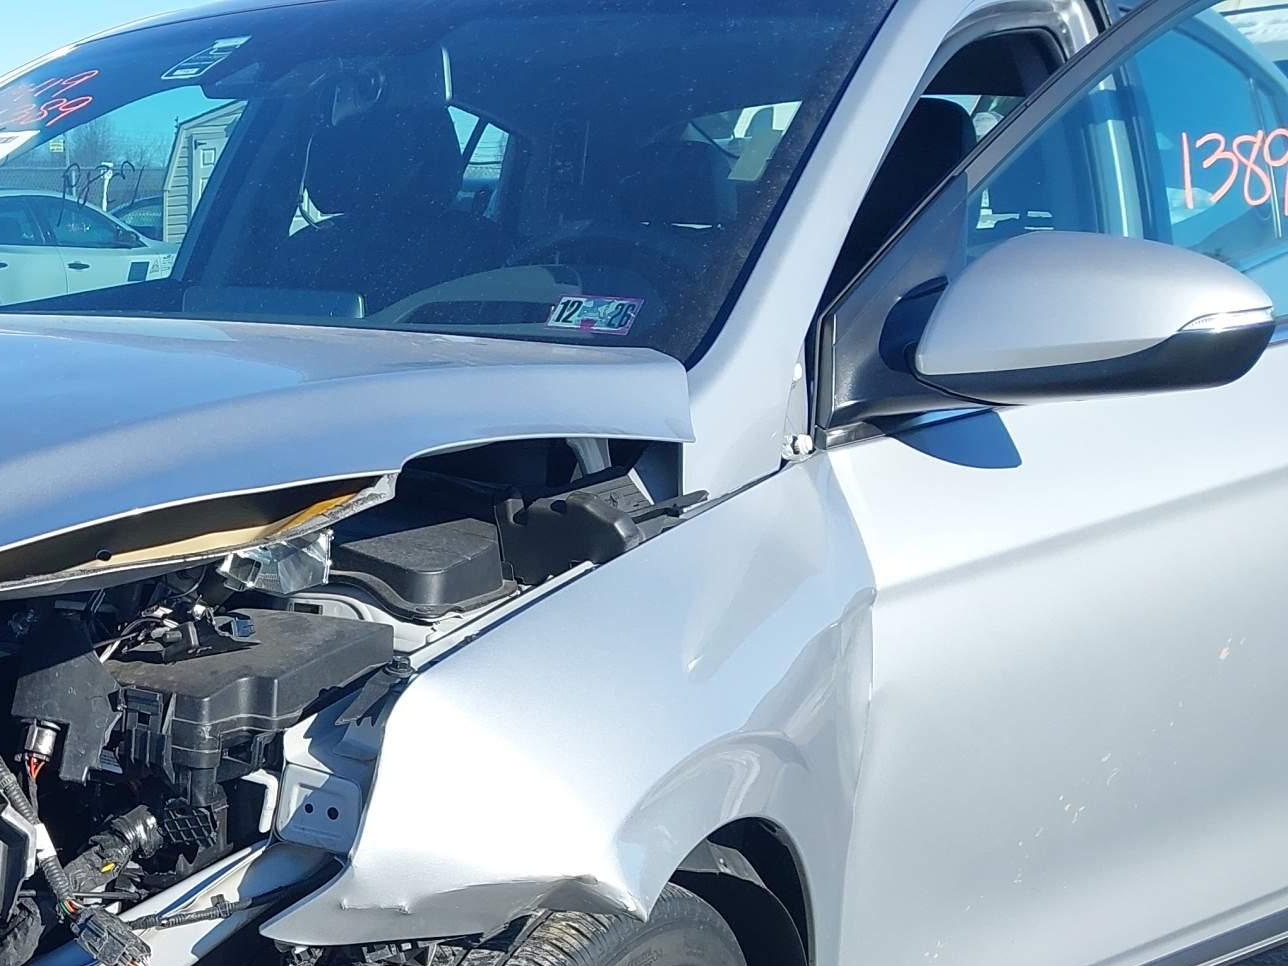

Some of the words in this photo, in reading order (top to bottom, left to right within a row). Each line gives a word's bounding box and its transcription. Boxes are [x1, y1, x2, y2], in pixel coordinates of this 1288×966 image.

[1180, 128, 1288, 217] 1389
[555, 299, 584, 323] 12
[608, 302, 636, 328] 26
